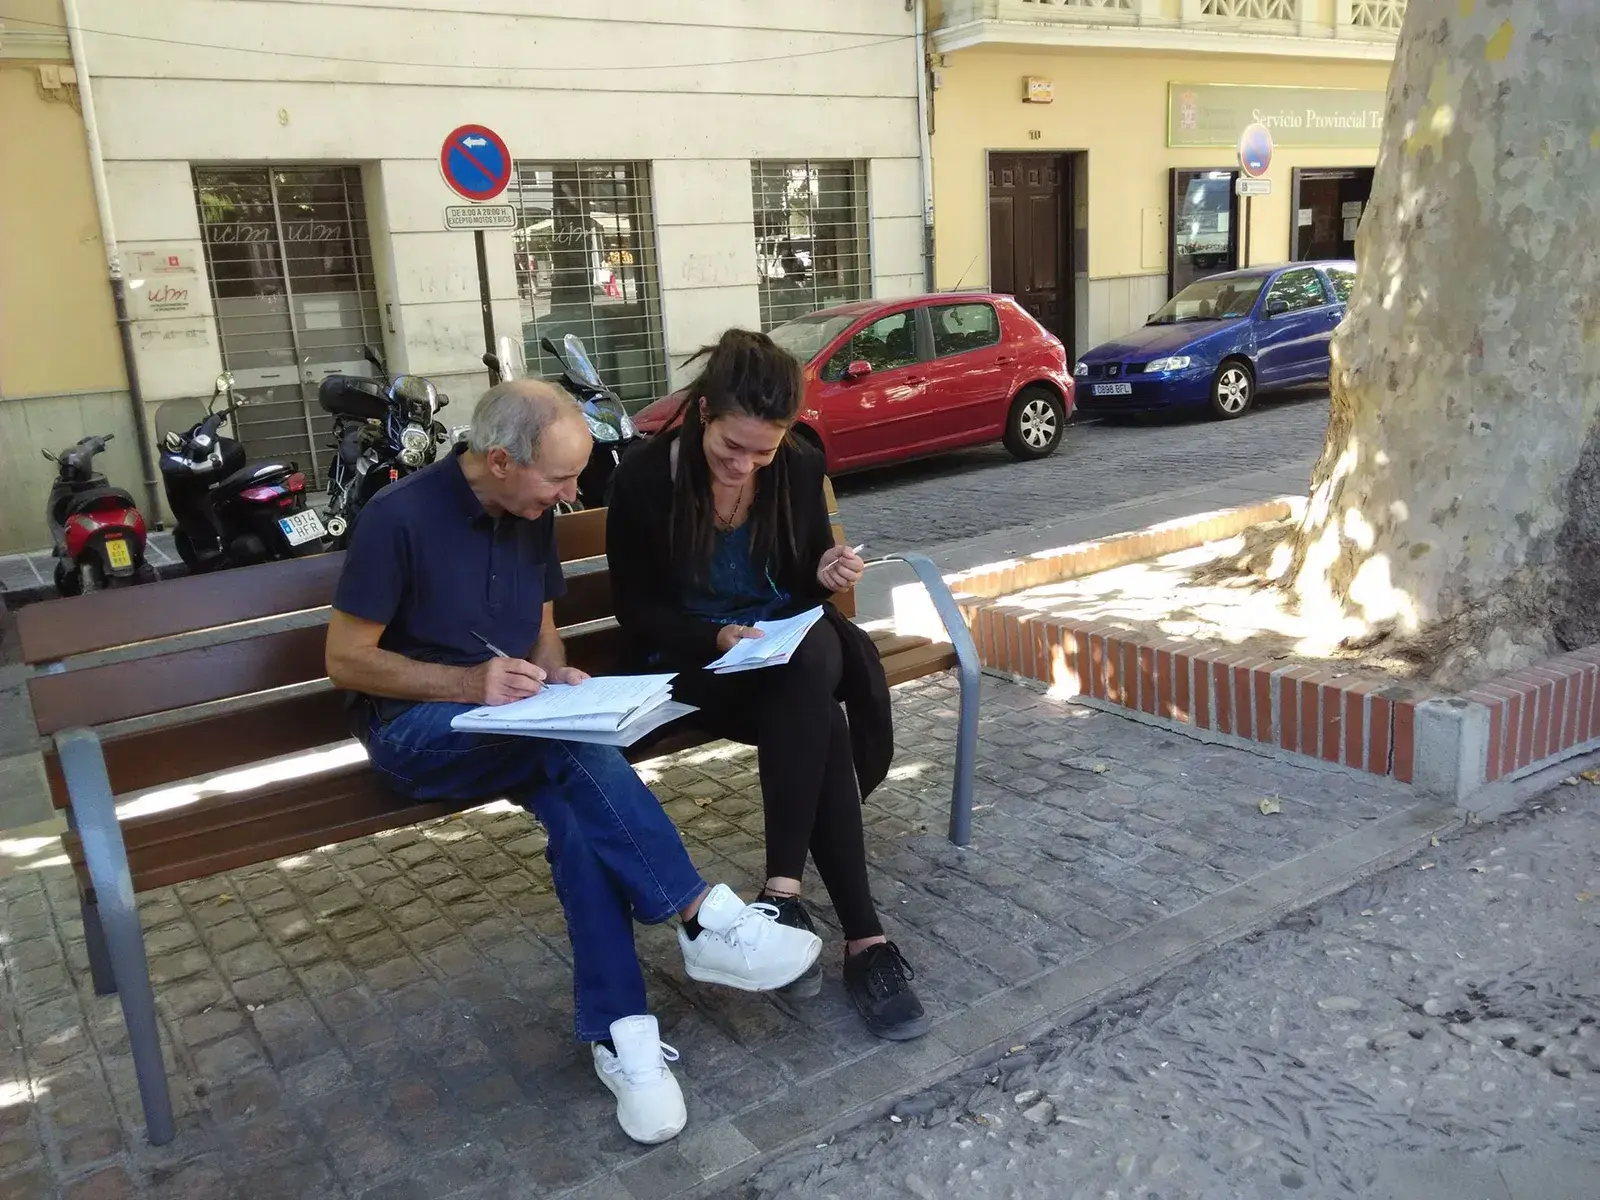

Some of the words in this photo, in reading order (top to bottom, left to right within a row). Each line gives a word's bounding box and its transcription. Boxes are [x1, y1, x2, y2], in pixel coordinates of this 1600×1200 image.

[1252, 109, 1302, 128] Servicio
[1306, 109, 1366, 128] Provincial
[1028, 129, 1041, 140] 10
[289, 513, 315, 528] 1914
[295, 522, 320, 538] HFR
